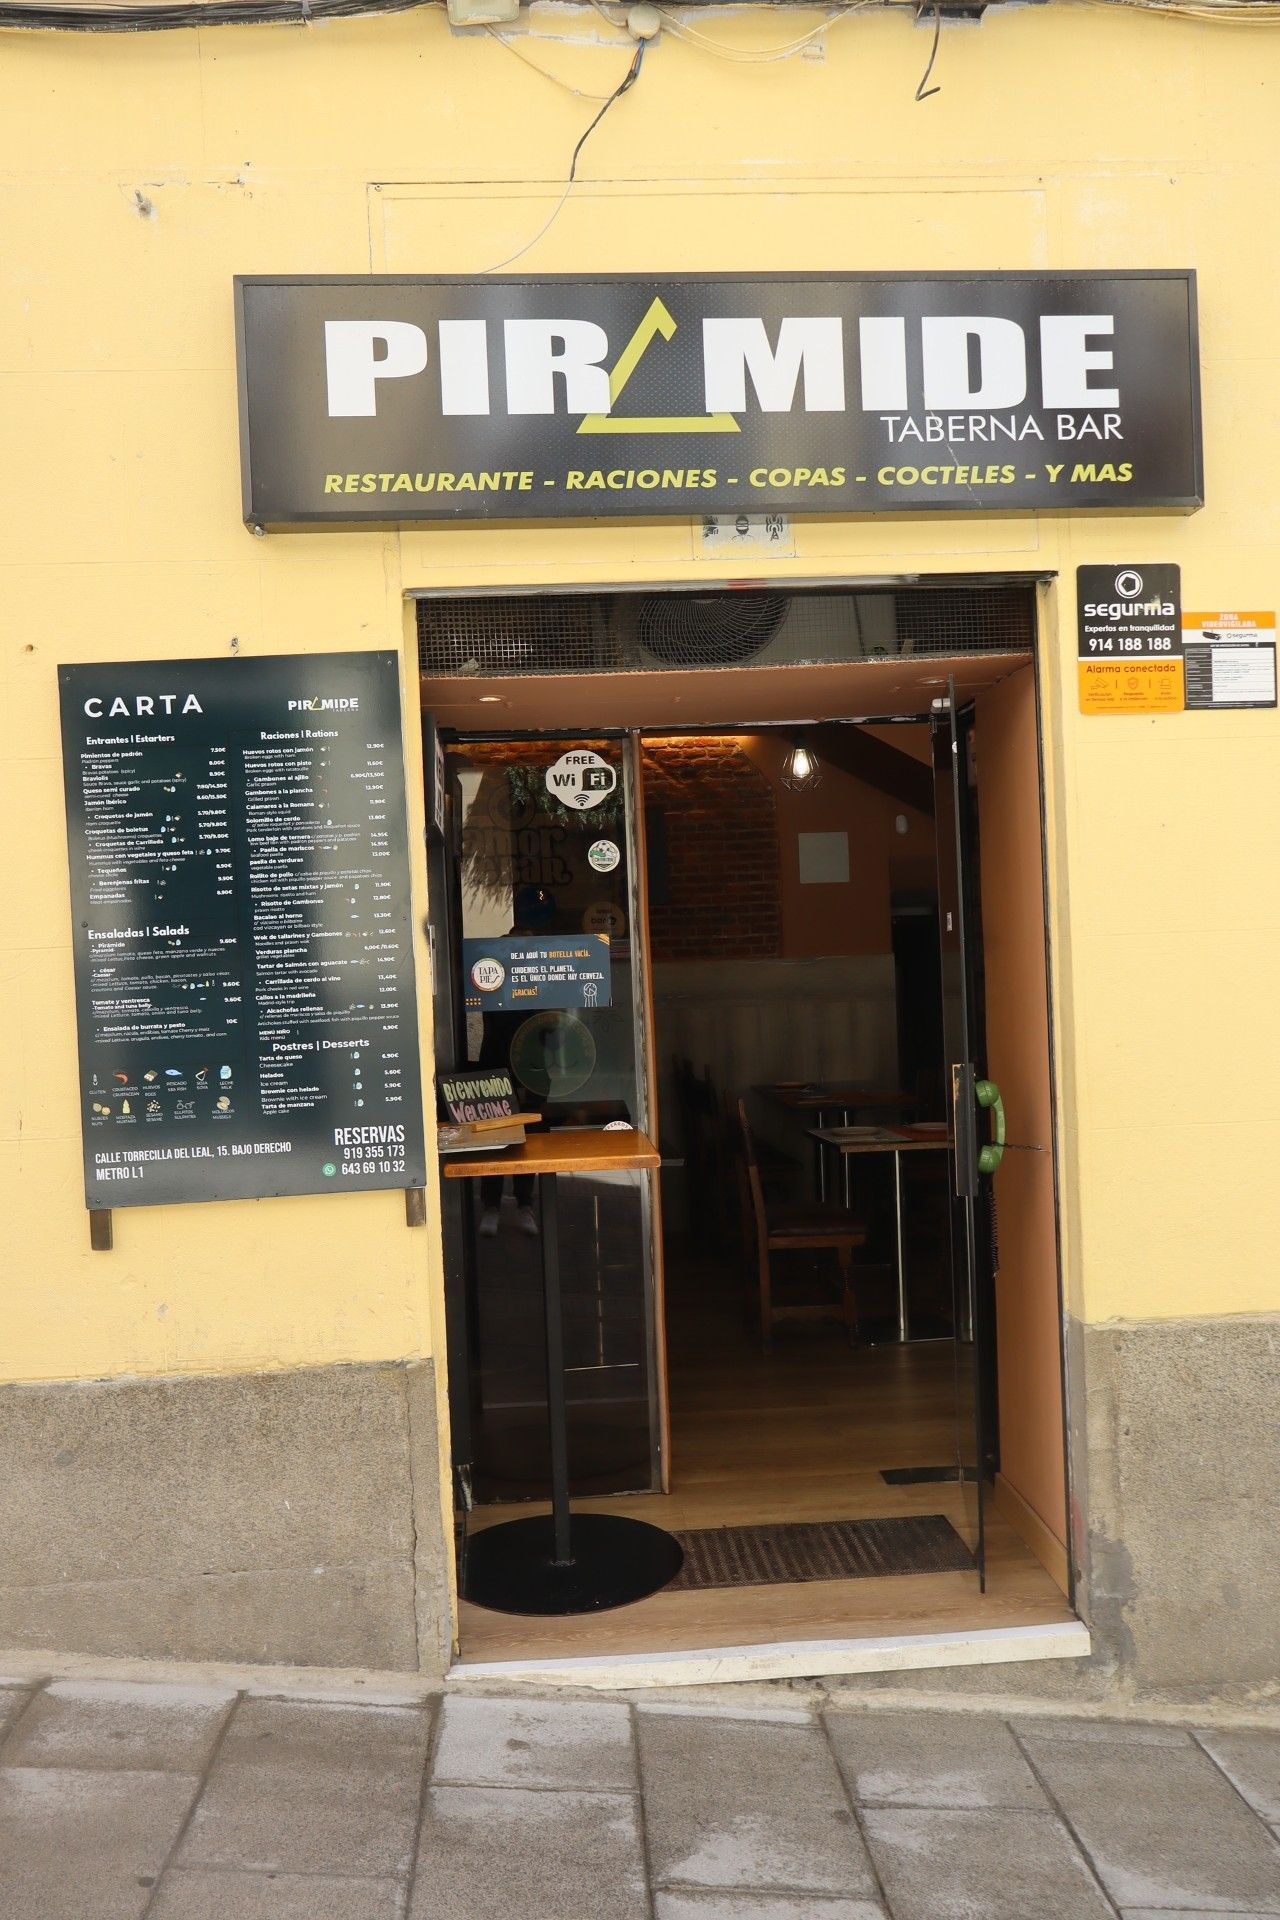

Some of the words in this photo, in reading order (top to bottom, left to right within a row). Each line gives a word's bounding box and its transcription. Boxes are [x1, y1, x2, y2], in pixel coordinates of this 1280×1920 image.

[880, 415, 1044, 443] TABERNA
[1057, 413, 1124, 441] BAR
[324, 471, 534, 494] RESTAURANTE
[565, 469, 718, 490] RACIONES
[749, 466, 846, 487] COPAS
[877, 464, 1016, 486] COCTELES
[1044, 463, 1066, 483] Y
[1069, 463, 1133, 483] MAS
[1084, 602, 1175, 620] segurma
[1085, 625, 1116, 633] Expertos
[1129, 624, 1175, 633] tranquilidad
[1089, 638, 1113, 651] 914
[1118, 638, 1142, 650] 188
[1147, 638, 1171, 650] 188
[1086, 664, 1121, 673] Alarma
[1124, 664, 1176, 673] conectada
[83, 693, 202, 718] CARTA
[86, 736, 129, 745] Entrantes
[135, 733, 175, 743] Estarters
[260, 730, 299, 740] Raciones
[305, 728, 338, 738] Rations
[566, 756, 595, 764] FREE
[553, 774, 575, 786] Wi
[590, 771, 606, 785] Fi
[87, 927, 144, 939] Ensaladas
[152, 924, 189, 936] Salads
[511, 966, 538, 974] CUIDEMOS
[272, 1041, 313, 1052] Postres
[322, 1038, 369, 1049] Desserts
[334, 1124, 405, 1145] RESERVAS
[94, 1151, 121, 1164] CALLE
[123, 1148, 173, 1162] TORRECILLA
[173, 1147, 189, 1159] DEL
[191, 1145, 214, 1158] LEAL,
[217, 1145, 230, 1156] 15.
[231, 1143, 252, 1155] BAJO
[253, 1141, 292, 1154] DERECHO
[343, 1146, 363, 1159] 919
[364, 1145, 384, 1158] 355
[387, 1144, 405, 1157] 173
[95, 1166, 130, 1180] METRO
[131, 1165, 143, 1178] L1
[341, 1162, 360, 1175] 643
[362, 1161, 375, 1174] 69
[379, 1160, 391, 1173] 10
[392, 1159, 405, 1172] 32
